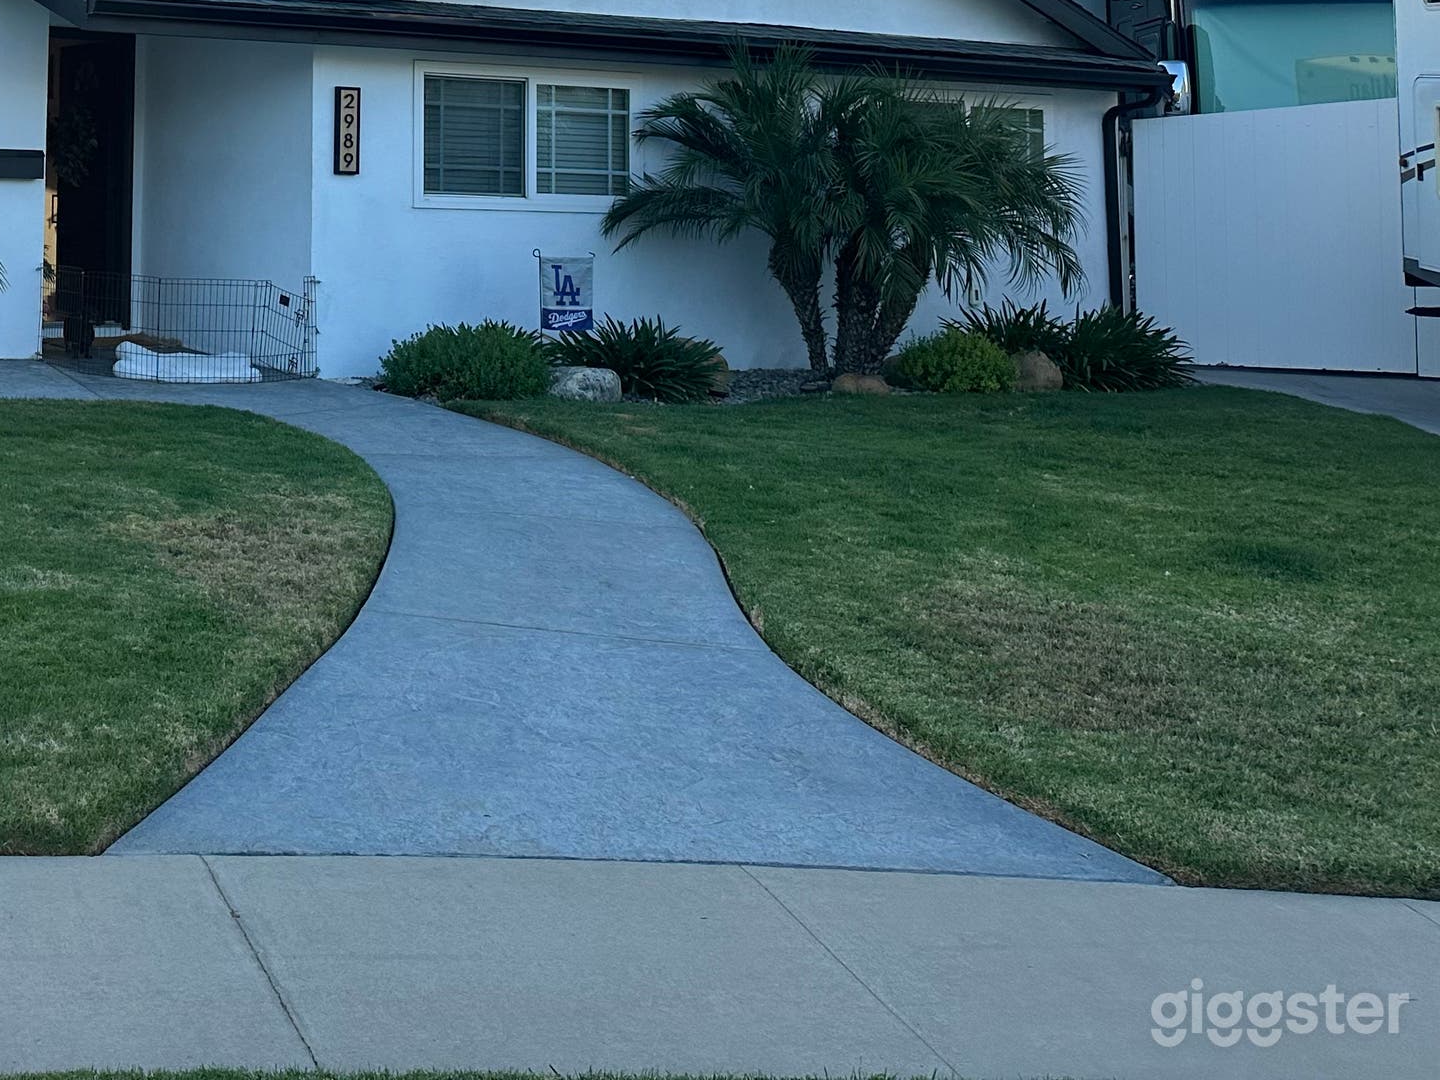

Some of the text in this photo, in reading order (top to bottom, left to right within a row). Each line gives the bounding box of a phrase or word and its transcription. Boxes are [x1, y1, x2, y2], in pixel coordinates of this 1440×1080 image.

[343, 93, 355, 168] 2989
[551, 264, 581, 306] LA
[548, 311, 587, 327] Dodgers
